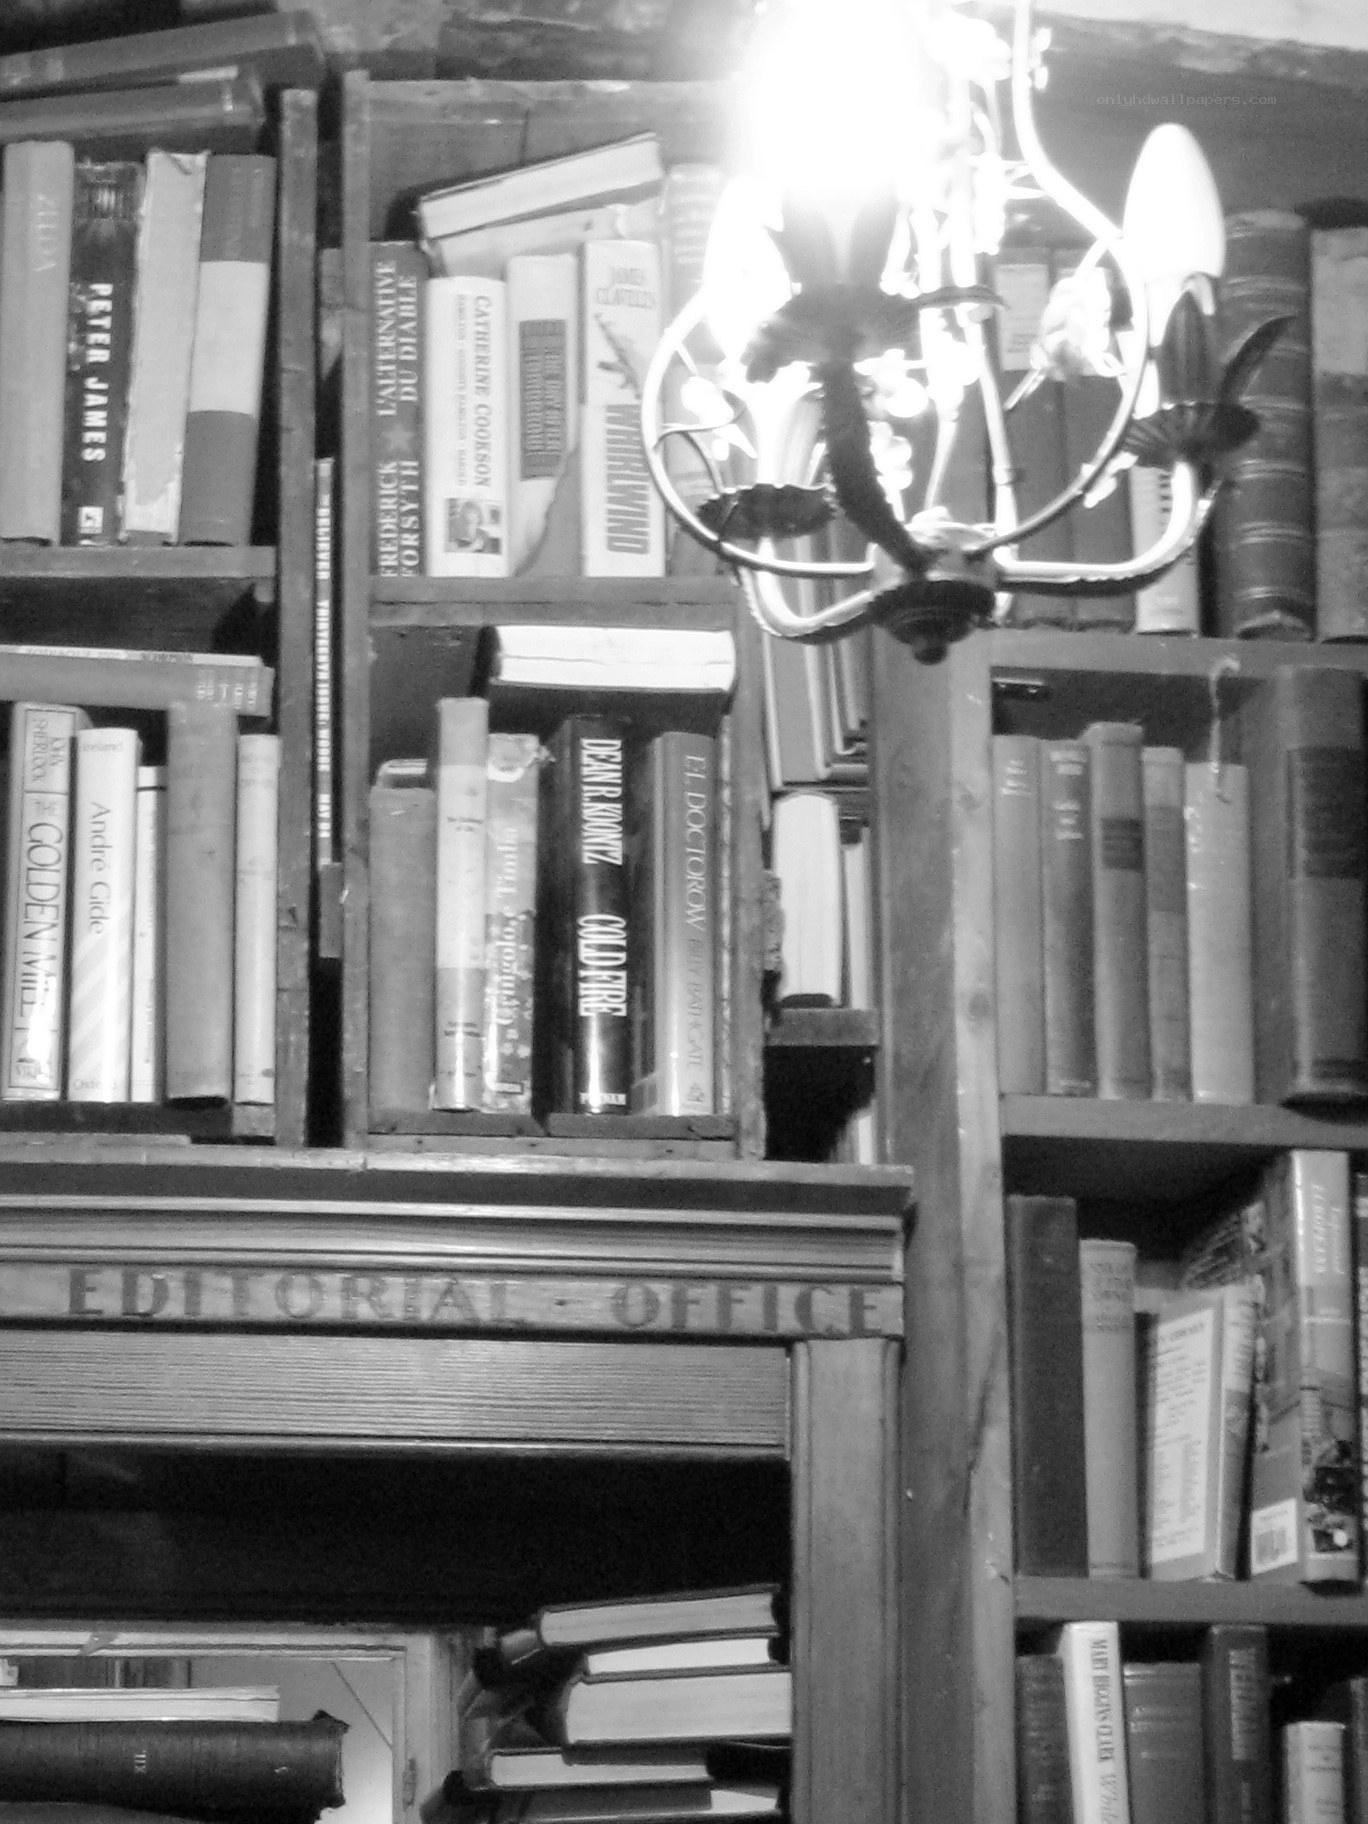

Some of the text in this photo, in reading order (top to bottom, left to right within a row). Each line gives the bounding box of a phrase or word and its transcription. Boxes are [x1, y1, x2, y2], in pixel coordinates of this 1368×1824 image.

[82, 283, 113, 462] PETER JAMES
[376, 261, 397, 416] L'ALTERNATIVE
[398, 274, 418, 402] DU DIABLE
[473, 295, 493, 487] CATHERINE COOKSON
[377, 460, 399, 579] FREDERICK
[400, 460, 420, 579] FORSYTH
[605, 404, 650, 555] WHIRLWIND
[316, 508, 331, 580] BELIEVER
[318, 793, 331, 819] MAY
[580, 738, 622, 783] DEAN
[22, 822, 63, 941] GOLDEN
[88, 801, 114, 935] André Gide
[684, 791, 706, 932] DOCTOROW
[577, 914, 627, 1016] COLD FIRE
[68, 1266, 529, 1330] EDITORIAL
[611, 1281, 890, 1337] OFFICE
[1094, 1638, 1114, 1673] MARY
[1098, 1725, 1120, 1763] CLARK
